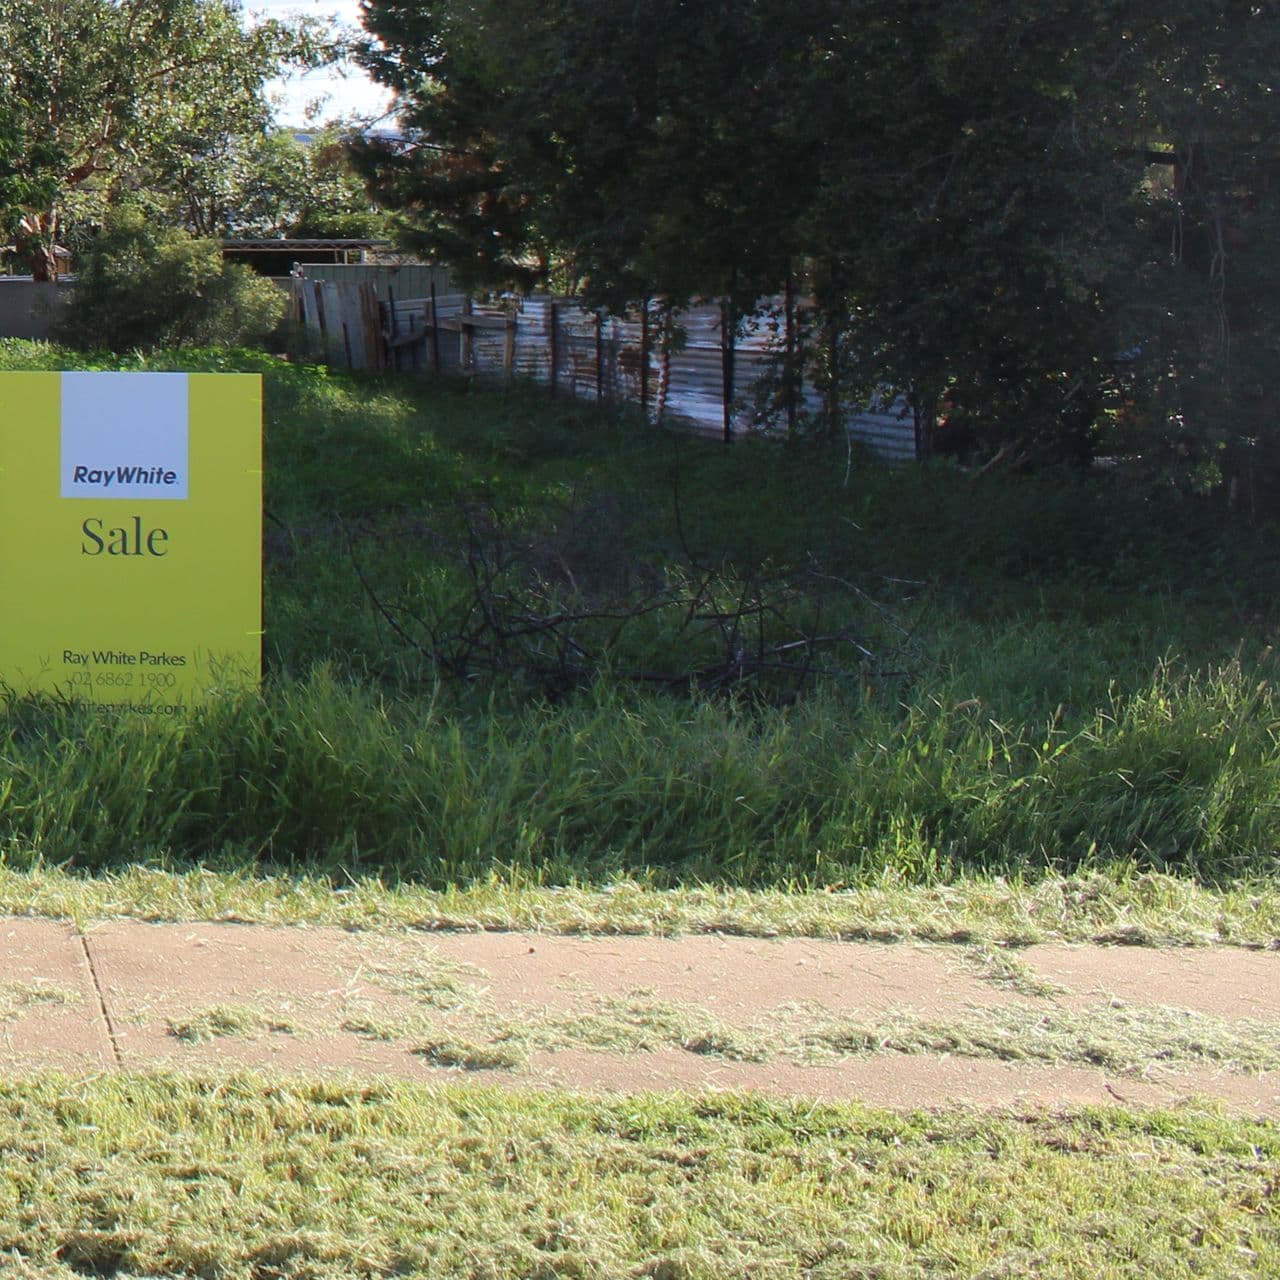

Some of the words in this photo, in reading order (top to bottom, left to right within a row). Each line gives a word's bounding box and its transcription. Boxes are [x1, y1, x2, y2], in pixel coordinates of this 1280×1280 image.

[81, 516, 169, 556] Sale
[63, 650, 89, 666] Ray
[92, 651, 136, 665] White
[140, 651, 186, 666] Parkes
[72, 672, 91, 686] 02
[96, 672, 133, 686] 6862
[140, 673, 176, 687] 1900
